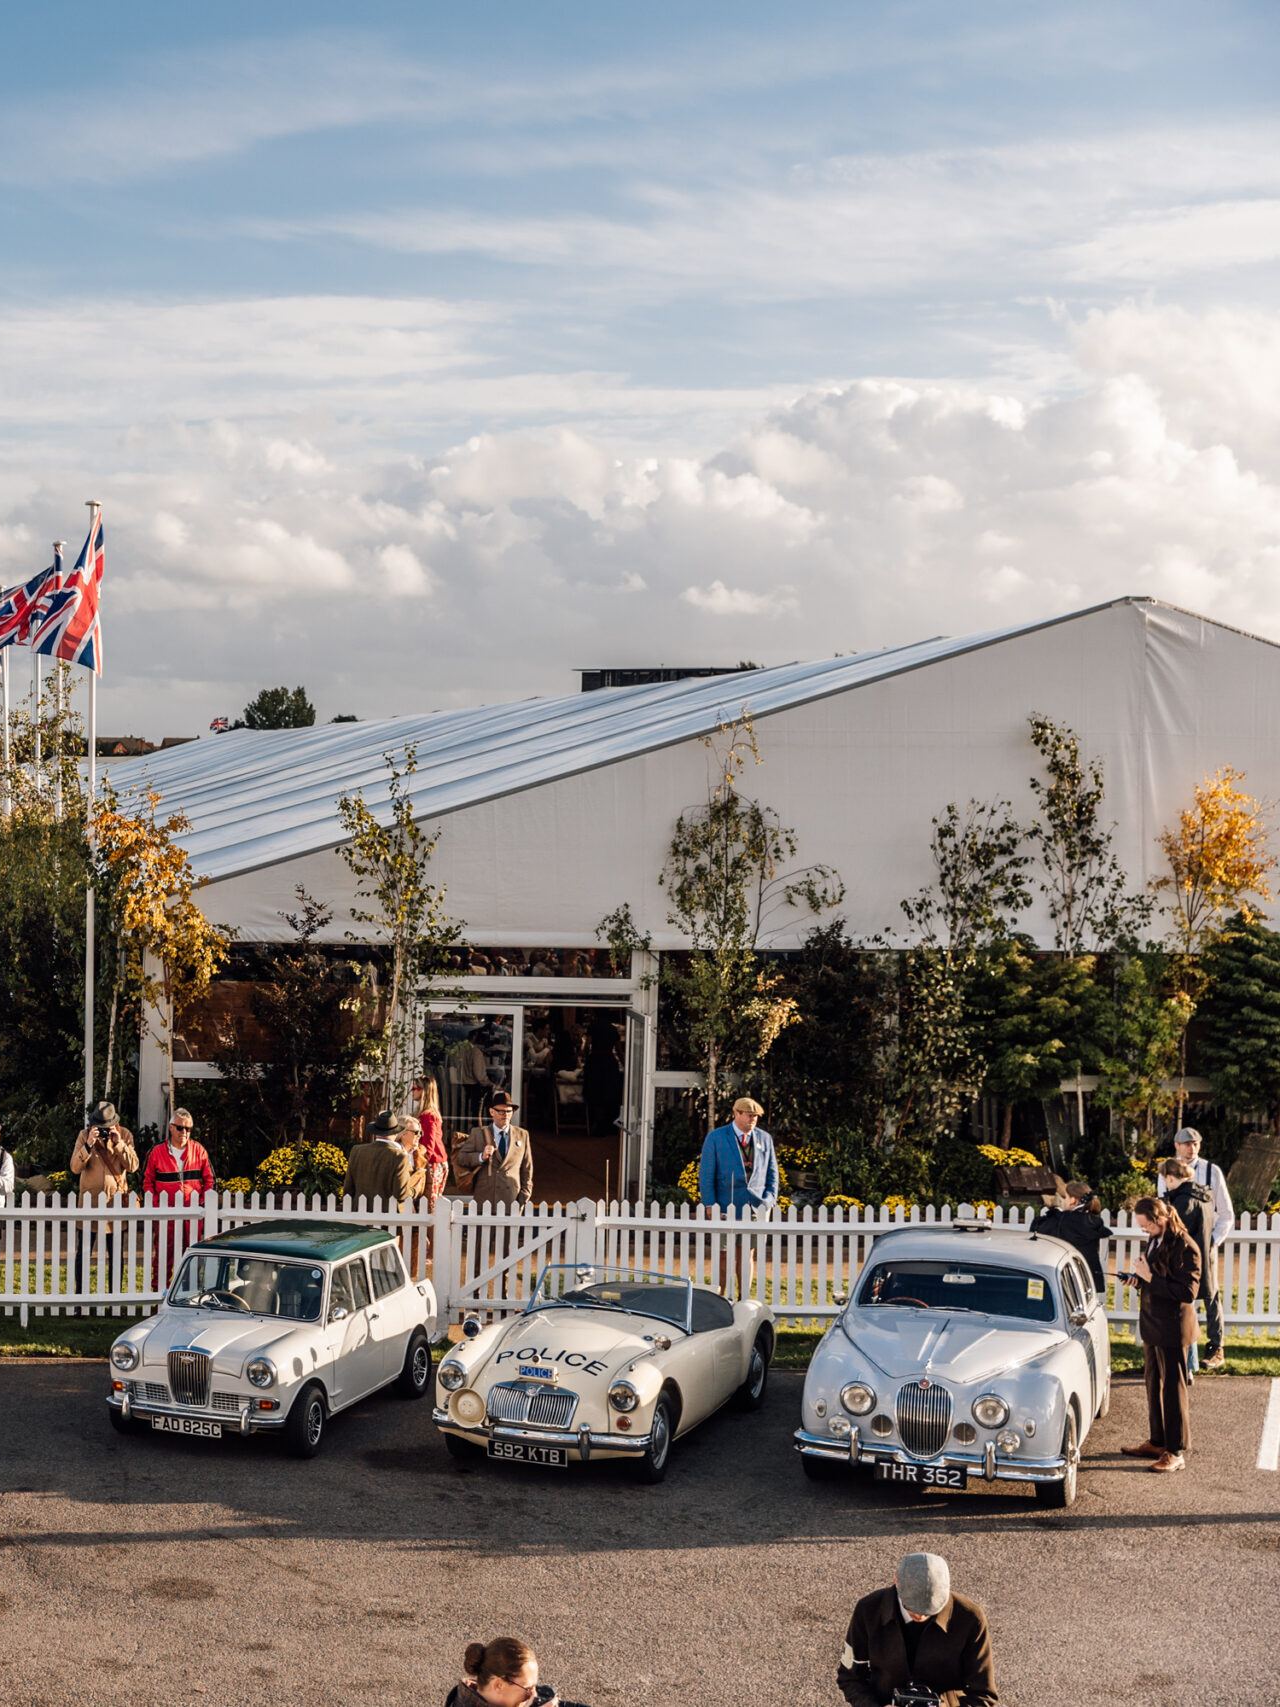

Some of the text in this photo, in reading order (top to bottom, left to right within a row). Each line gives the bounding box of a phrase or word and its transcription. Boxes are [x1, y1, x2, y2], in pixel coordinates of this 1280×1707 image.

[495, 1347, 609, 1377] POLICE
[520, 1366, 553, 1379] POLICE
[153, 1415, 221, 1436] FAD 825C
[494, 1442, 560, 1463] 592 KTB
[880, 1462, 962, 1486] THR 362
